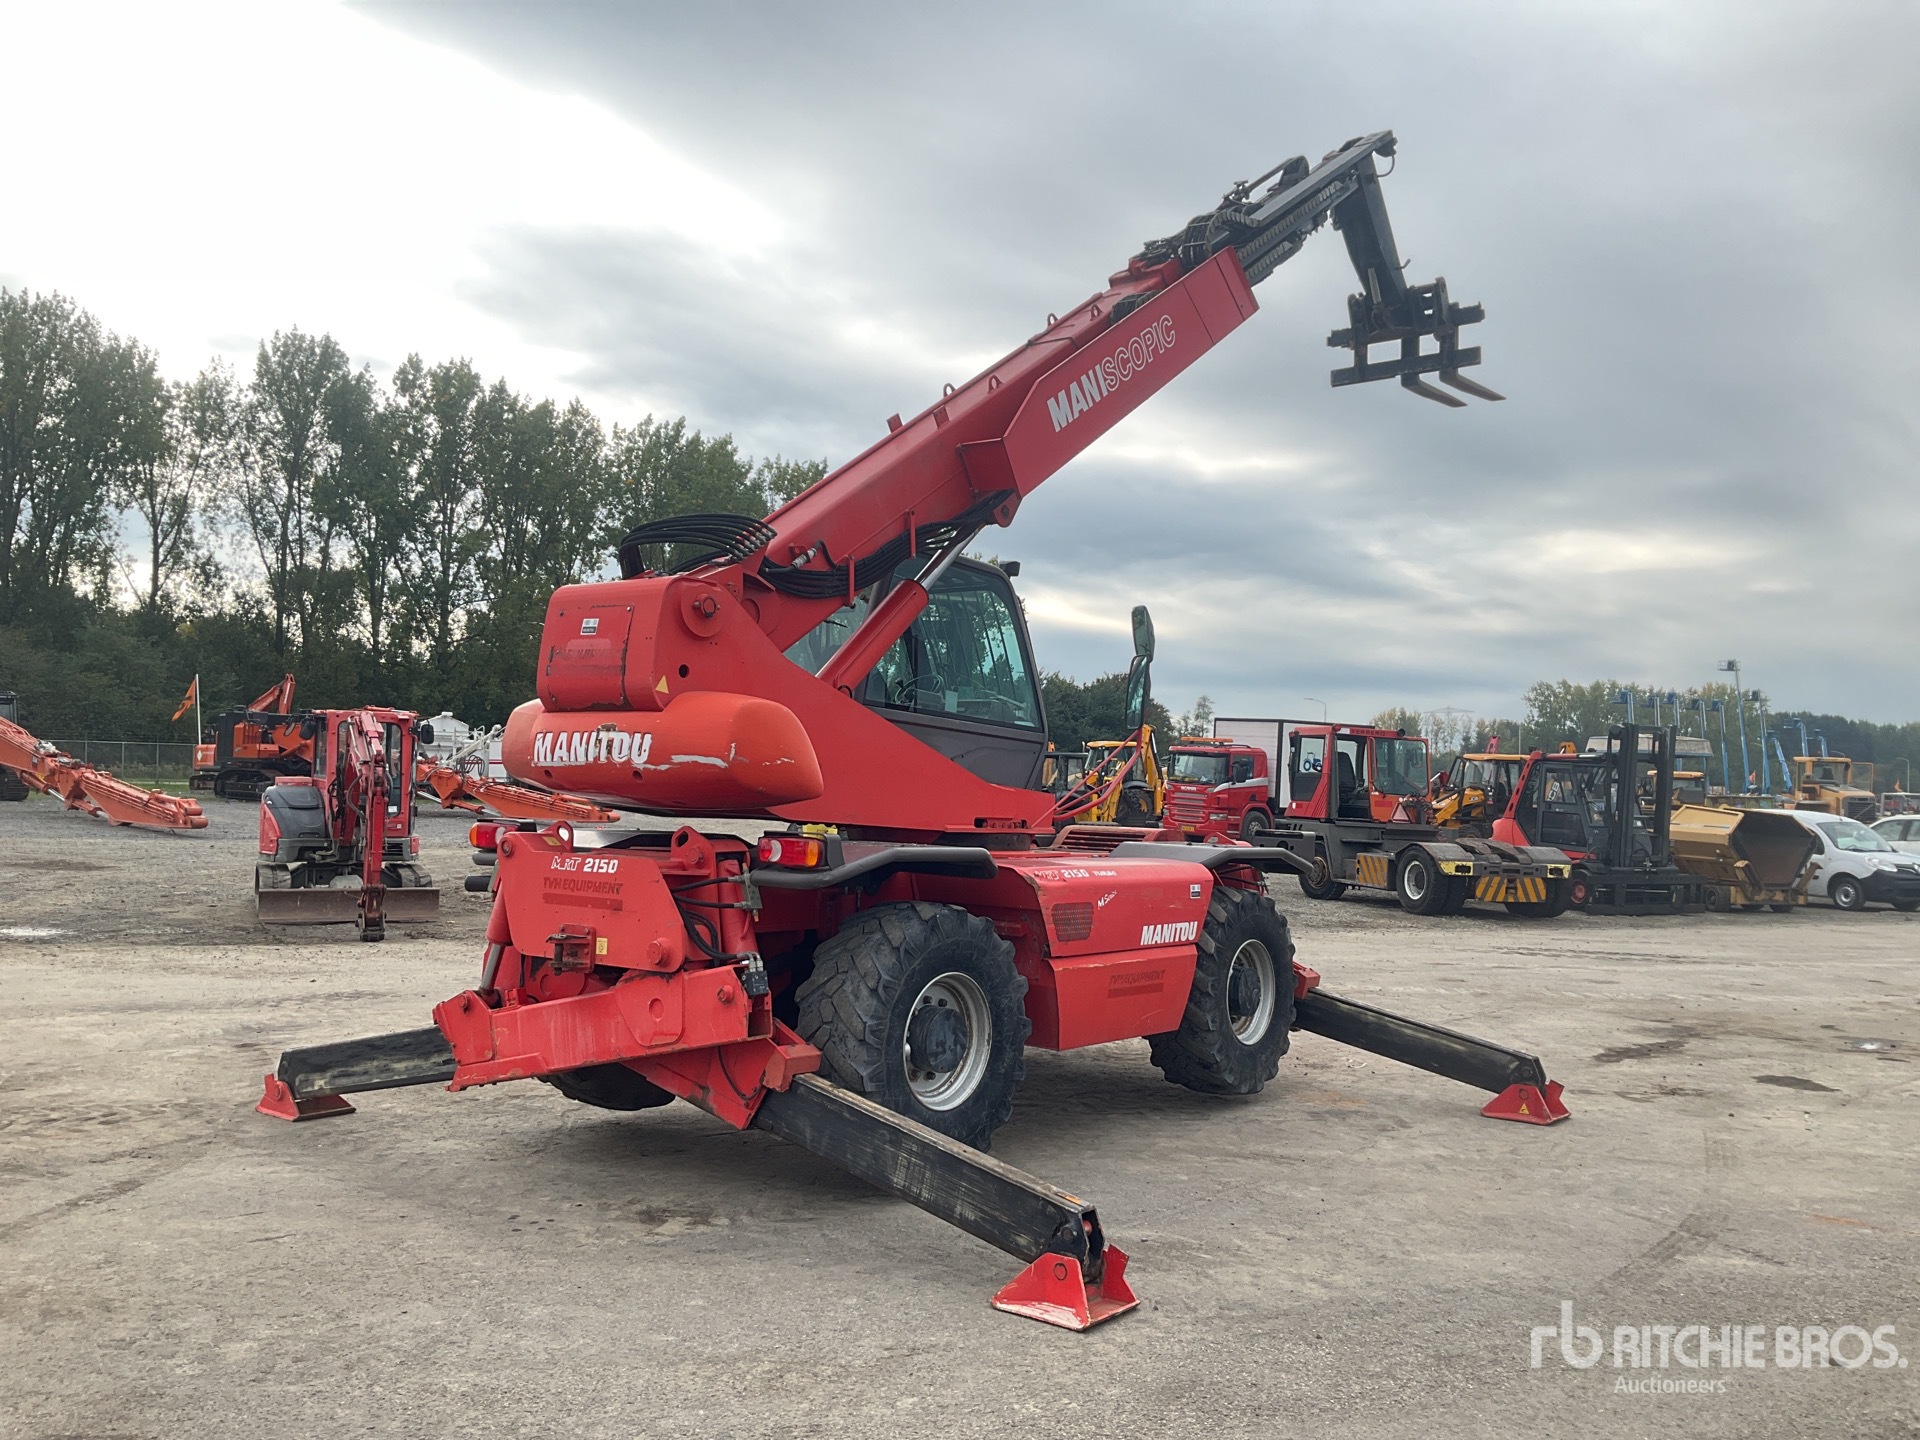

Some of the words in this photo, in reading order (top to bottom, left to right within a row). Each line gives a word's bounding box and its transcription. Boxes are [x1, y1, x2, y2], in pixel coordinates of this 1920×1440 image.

[1047, 315, 1175, 432] MANISCOPIC
[533, 730, 652, 764] MANITOU
[582, 857, 619, 874] 2150
[1061, 868, 1090, 878] 2150
[1140, 921, 1199, 946] MANITOU
